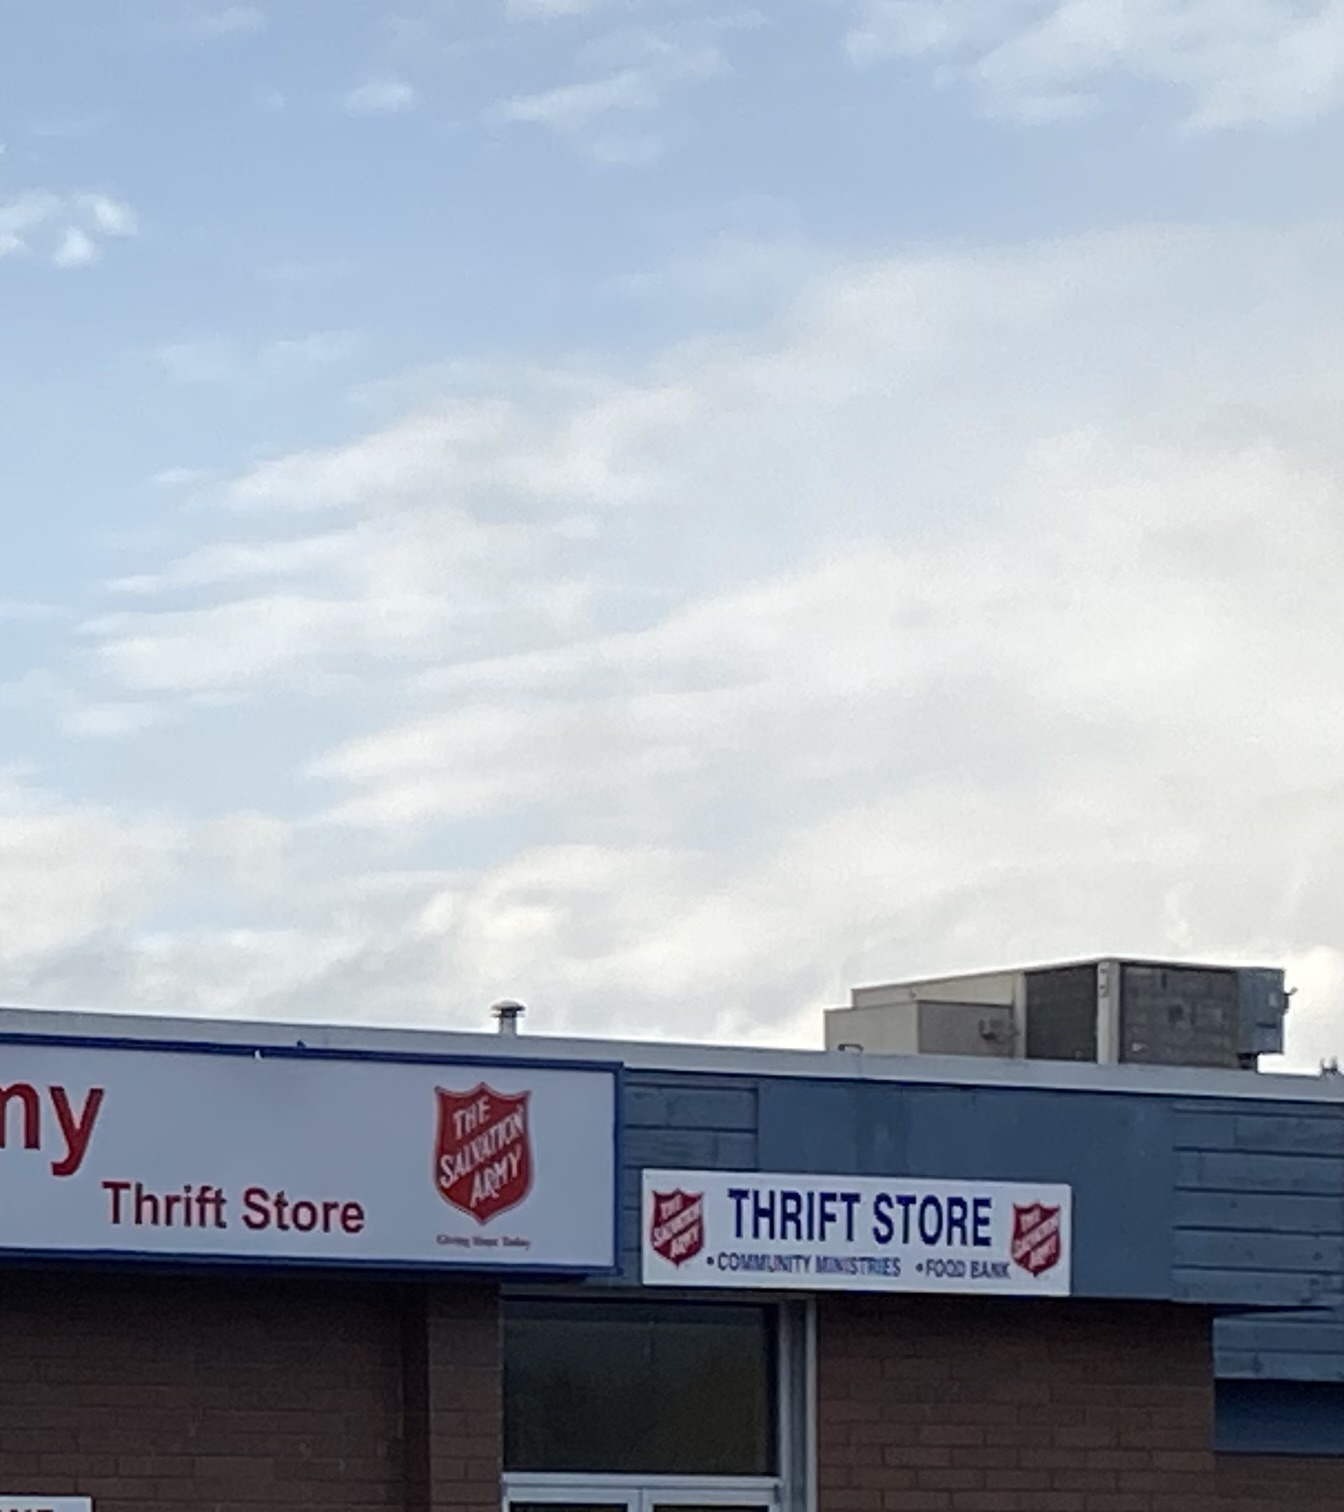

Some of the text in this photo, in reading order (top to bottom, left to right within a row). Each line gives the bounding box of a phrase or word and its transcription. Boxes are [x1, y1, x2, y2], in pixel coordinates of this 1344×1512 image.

[439, 1103, 526, 1189] SALVATION
[452, 1095, 492, 1141] THE
[468, 1143, 523, 1209] ARMY
[102, 1181, 366, 1235] Thrift Store
[727, 1188, 864, 1244] THRIFT
[872, 1193, 993, 1248] STORE
[716, 1252, 1012, 1281] COMMUNITY MINISTRIES FOOD BANK
